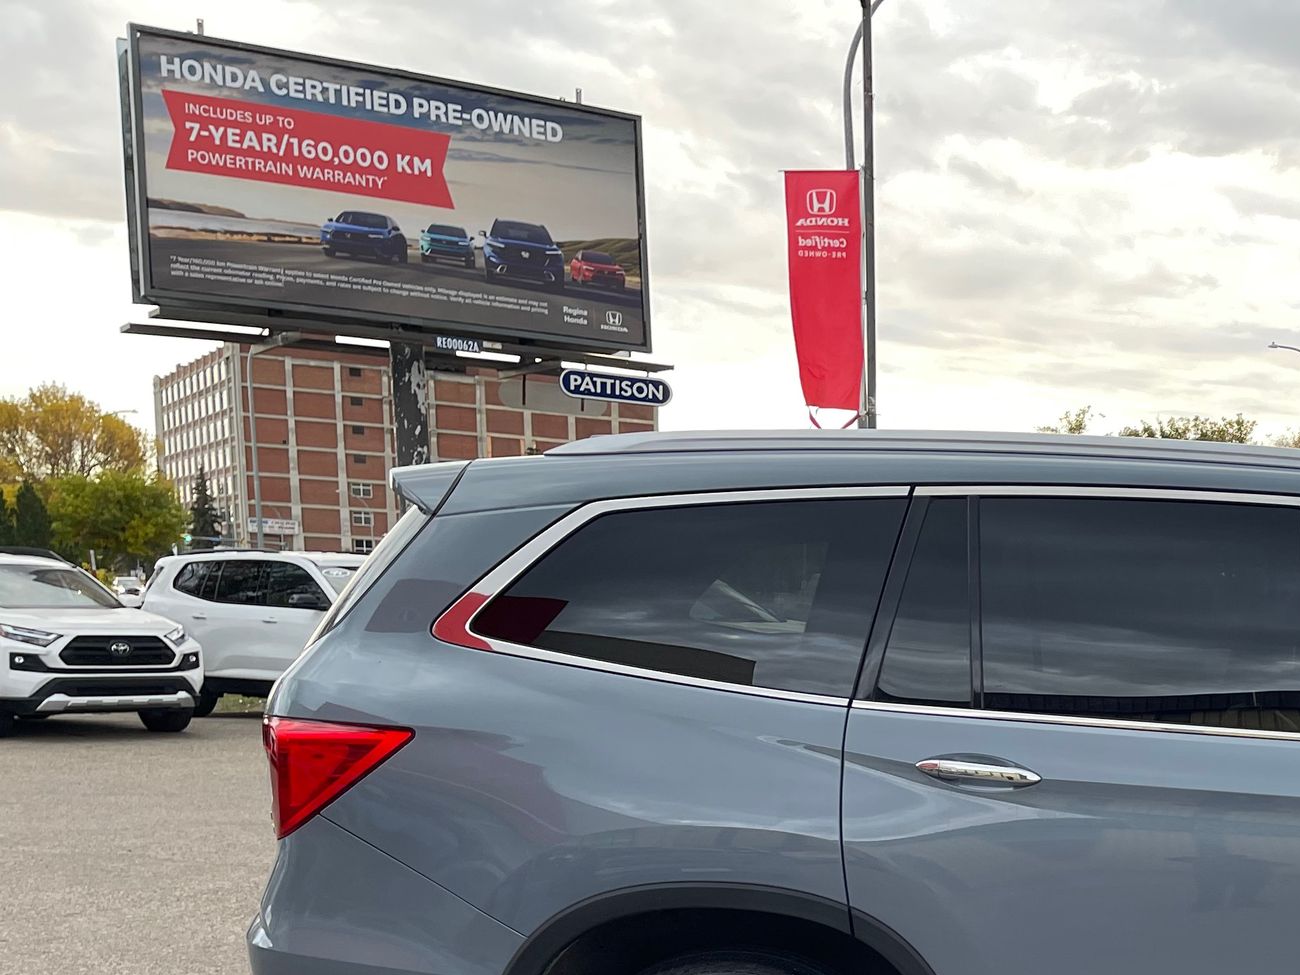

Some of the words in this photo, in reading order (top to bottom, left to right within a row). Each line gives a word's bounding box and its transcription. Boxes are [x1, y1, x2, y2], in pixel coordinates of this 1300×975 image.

[159, 55, 265, 92] HONDA
[269, 73, 408, 116] CERTIFIED
[412, 97, 564, 144] PRE-OWNED
[184, 102, 253, 123] INCLUDES
[256, 113, 274, 126] UP
[276, 116, 295, 130] TO
[185, 121, 389, 171] 7-YEAR/160,000
[396, 153, 433, 178] KM
[187, 149, 293, 177] POWERTRAIN
[563, 306, 588, 316] Regina
[564, 315, 588, 325] Honda
[436, 336, 480, 353] RE00062A
[569, 374, 664, 401] PATTISON
